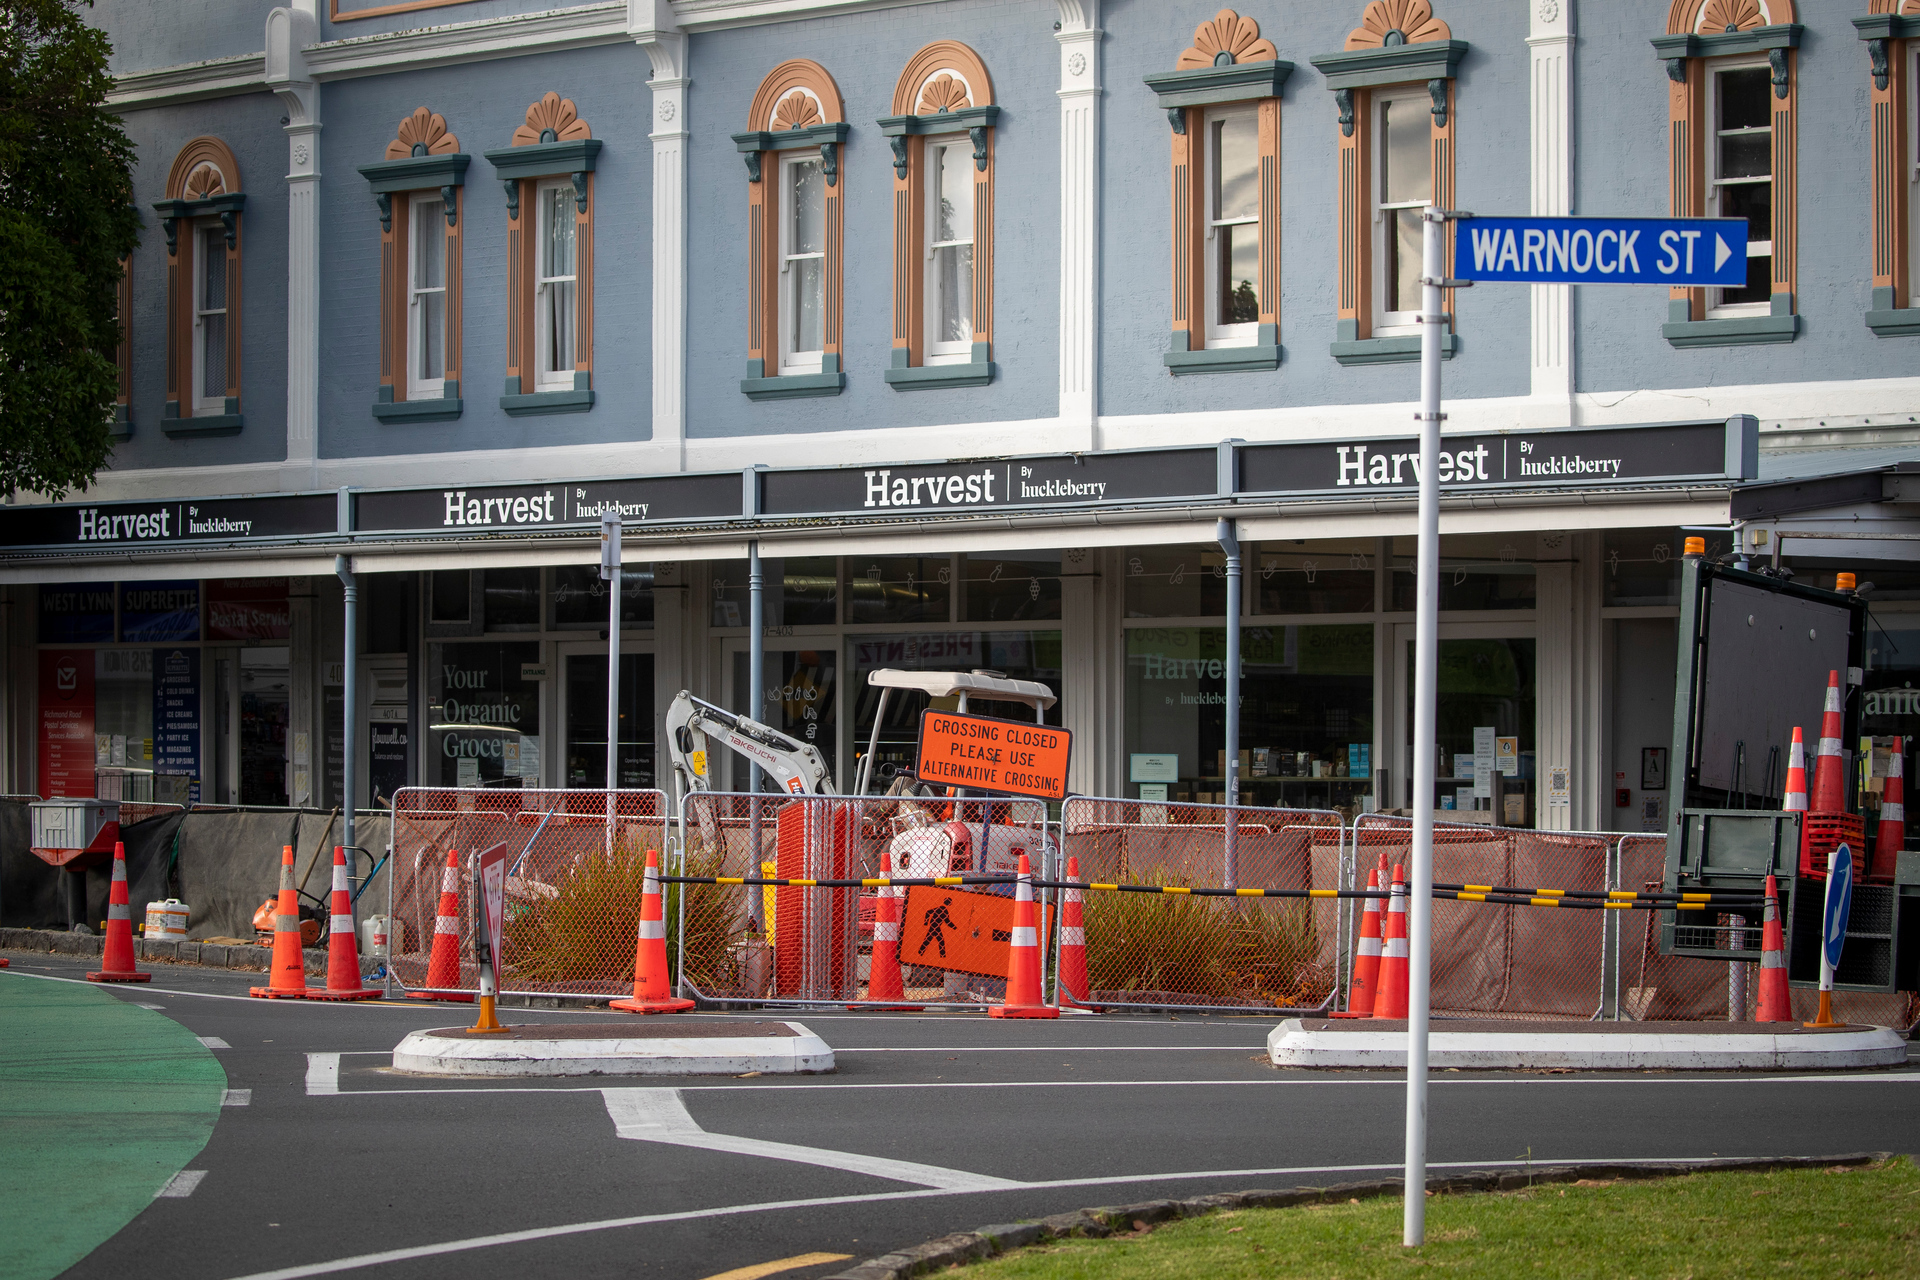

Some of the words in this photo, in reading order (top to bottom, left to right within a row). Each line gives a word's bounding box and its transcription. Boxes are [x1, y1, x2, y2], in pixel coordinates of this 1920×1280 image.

[1471, 228, 1641, 275] WARNOCK
[1656, 229, 1702, 275] ST
[1520, 441, 1534, 455] By
[1021, 465, 1033, 479] By
[1520, 455, 1623, 480] huckleberry
[576, 488, 587, 500] By
[864, 468, 995, 507] Harvest
[1020, 478, 1107, 500] huckleberry
[189, 506, 199, 518] By
[443, 490, 555, 526] Harvest
[576, 500, 650, 520] huckleberry
[78, 508, 171, 541] Harvest
[189, 518, 252, 536] huckleberry
[223, 579, 239, 589] New
[240, 578, 269, 588] Zealand
[269, 578, 286, 587] Post
[43, 592, 77, 612] WEST
[79, 591, 114, 611] LYNN
[126, 589, 197, 611] SUPERETTE
[209, 609, 248, 628] Postal
[251, 608, 290, 627] Servic
[329, 664, 344, 682] 40
[1143, 653, 1246, 680] Harvet
[442, 664, 489, 690] Your
[166, 687, 178, 695] COLD
[179, 687, 195, 695] DRINKS
[1165, 696, 1174, 706] By
[1180, 691, 1245, 708] hucklebey
[166, 699, 184, 707] SNACKS
[442, 696, 521, 727] Organic
[44, 710, 68, 718] Richmond
[69, 710, 82, 718] Road
[166, 710, 174, 718] ICE
[175, 710, 193, 718] CREAMS
[44, 721, 58, 729] Postal
[59, 720, 79, 729] Services
[933, 718, 999, 741] CROSSING
[1006, 729, 1058, 749] CLOSED
[442, 732, 511, 758] Grocer
[950, 742, 1003, 763] PLEASE
[1010, 750, 1036, 767] USE
[166, 757, 175, 765] TOP
[1648, 758, 1659, 773] A
[923, 759, 998, 783] ALTERNATIVE
[1004, 771, 1059, 792] CROSSING
[489, 872, 501, 906] GIVE
